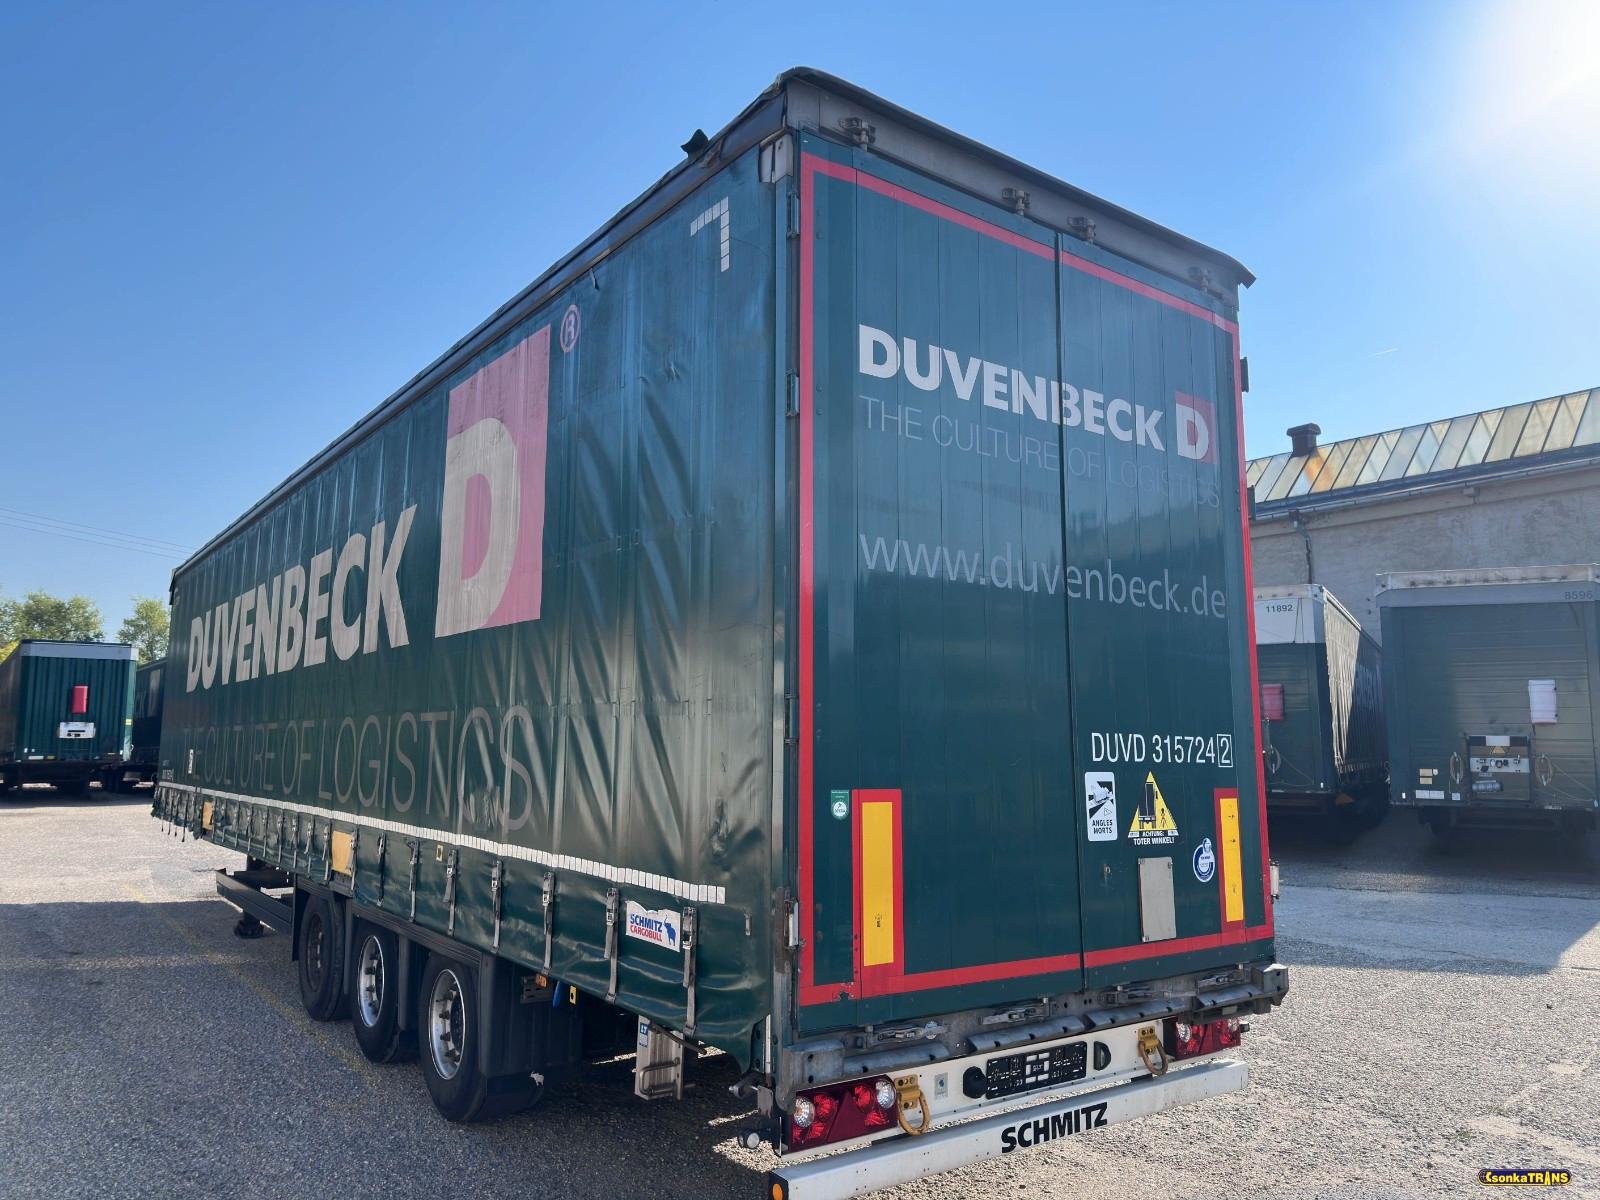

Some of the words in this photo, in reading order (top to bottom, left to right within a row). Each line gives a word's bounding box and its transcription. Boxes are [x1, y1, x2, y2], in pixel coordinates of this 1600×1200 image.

[858, 324, 1166, 452] DUVENBECK
[858, 395, 923, 441] THE
[932, 414, 1060, 473] CULTURE
[1067, 447, 1101, 479] OF
[1107, 459, 1221, 509] LOGISTICS
[859, 533, 1227, 618] www.duvenbeck.de
[186, 504, 418, 693] DUVENBECK
[1265, 603, 1293, 613] 11892
[204, 722, 279, 791] CULTURE
[281, 719, 315, 796] OF
[318, 705, 533, 831] LOGISTICS
[1091, 732, 1146, 763] DUVD
[1092, 819, 1113, 827] ANGLES
[1133, 837, 1151, 845] TOTER
[630, 913, 663, 933] SCHMITZ
[630, 924, 663, 943] CARGOBULL
[1001, 1102, 1109, 1154] SCHMITZ
